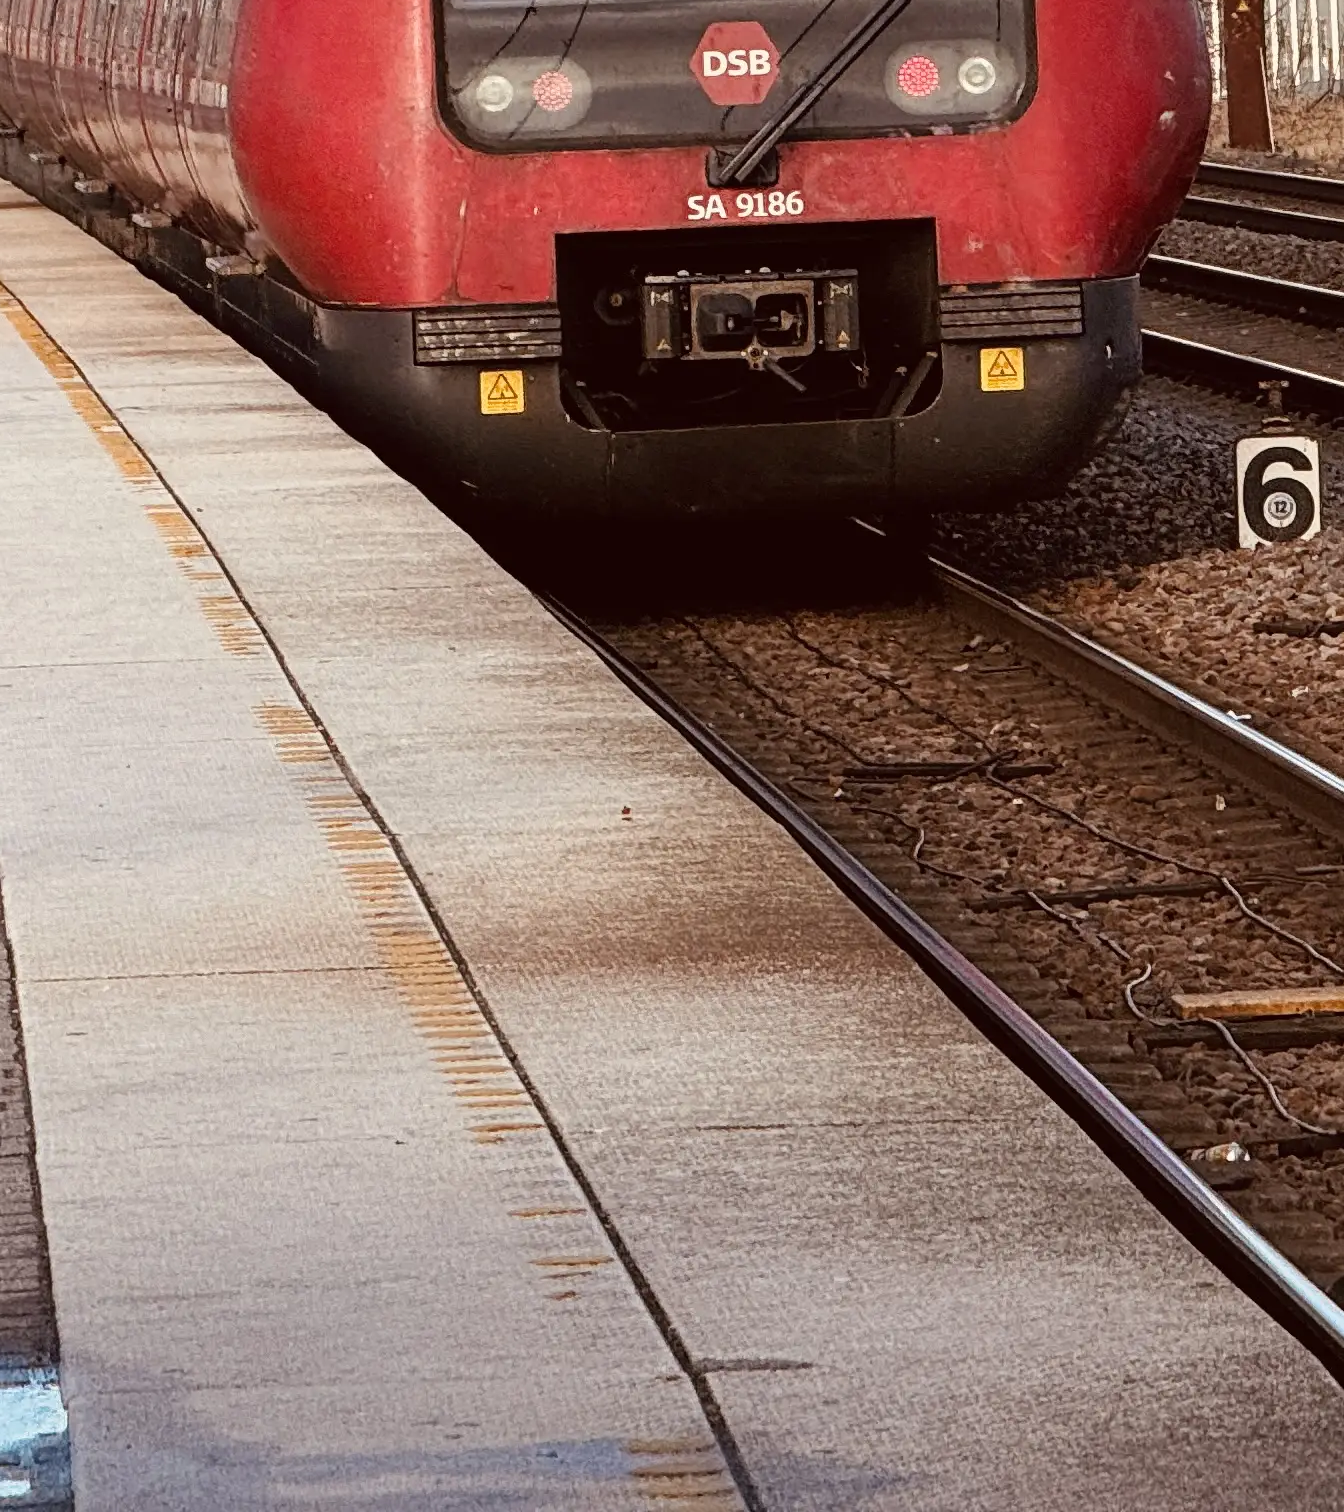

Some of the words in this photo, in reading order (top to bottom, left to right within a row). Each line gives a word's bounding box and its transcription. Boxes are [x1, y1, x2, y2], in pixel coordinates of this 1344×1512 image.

[702, 49, 772, 78] DSB
[687, 194, 728, 220] SA
[735, 190, 805, 218] 9186
[1242, 445, 1315, 544] 6
